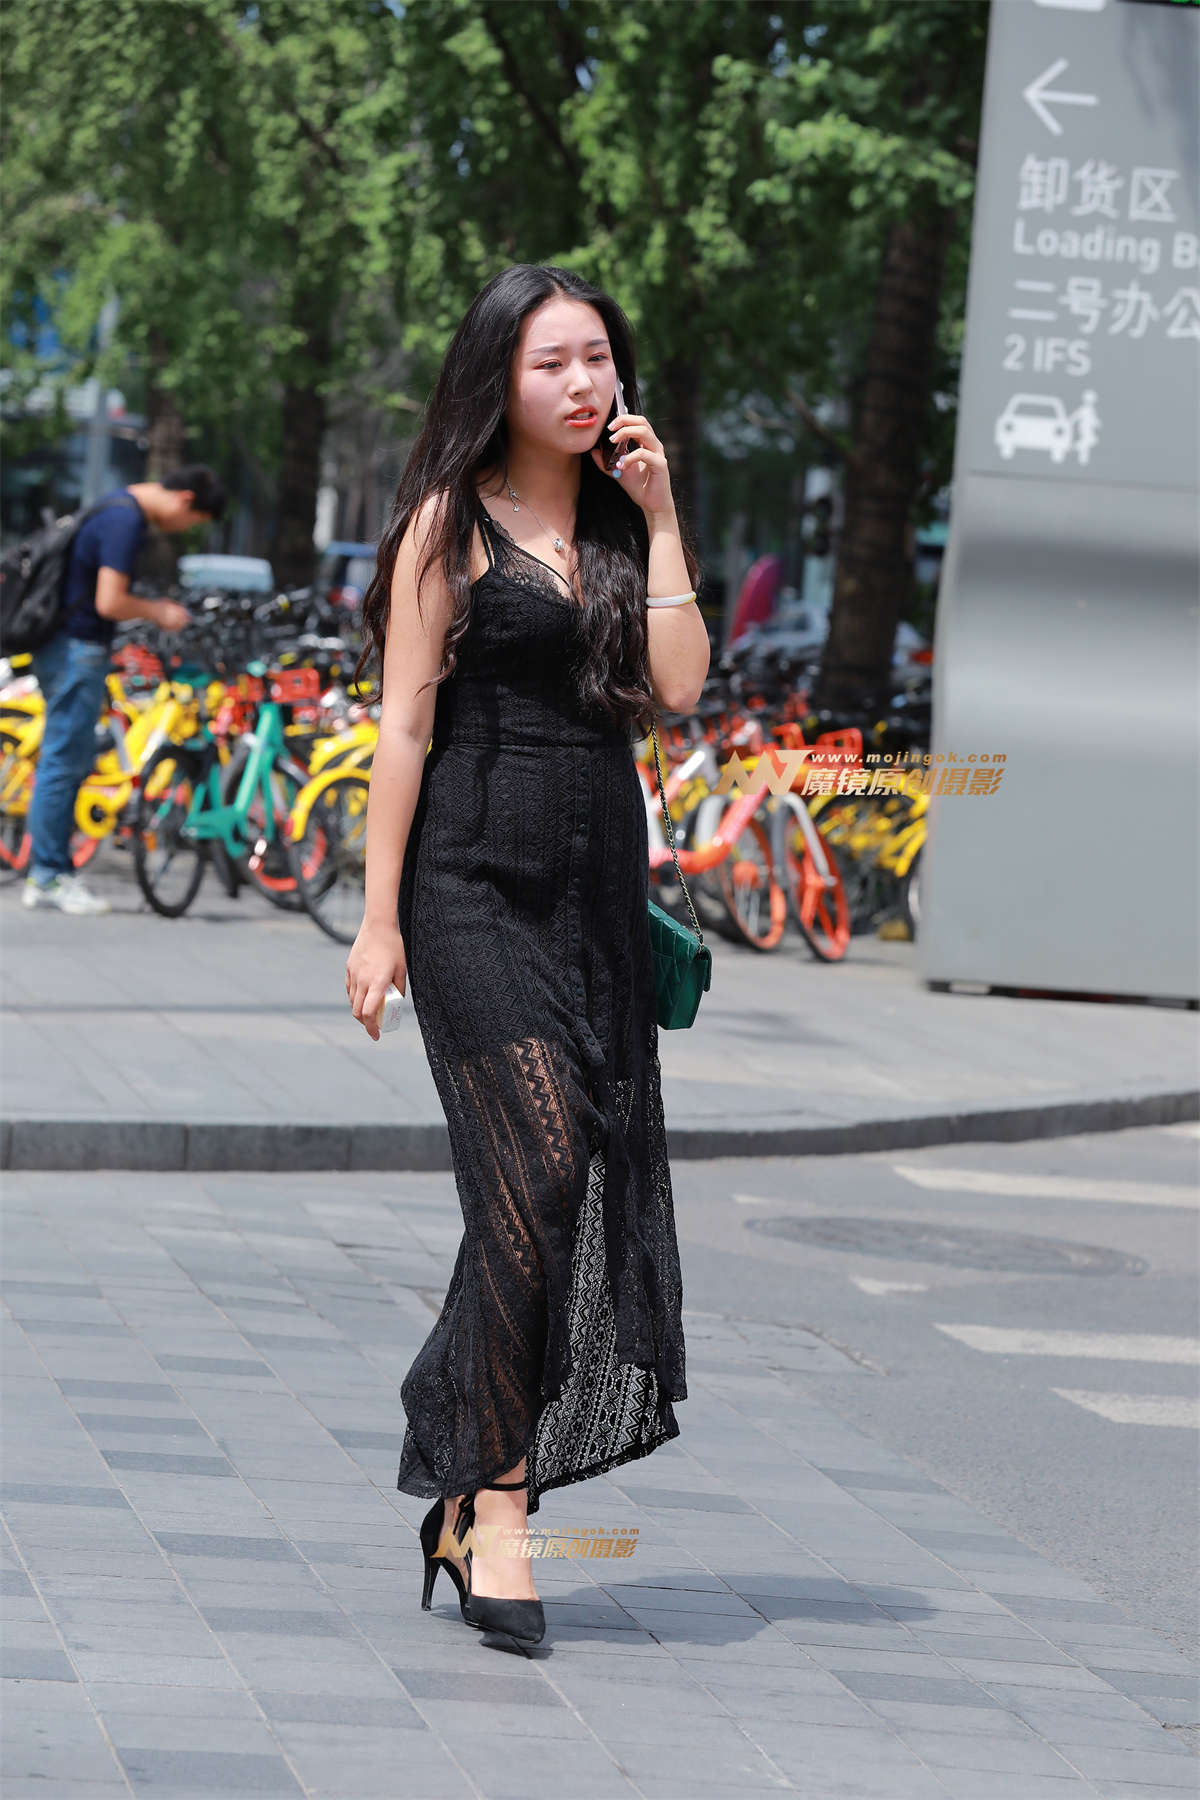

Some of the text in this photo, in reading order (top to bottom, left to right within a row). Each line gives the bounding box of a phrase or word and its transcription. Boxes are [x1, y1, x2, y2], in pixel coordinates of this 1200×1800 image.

[1017, 153, 1180, 223] 卸货区
[1013, 217, 1200, 274] Loading B
